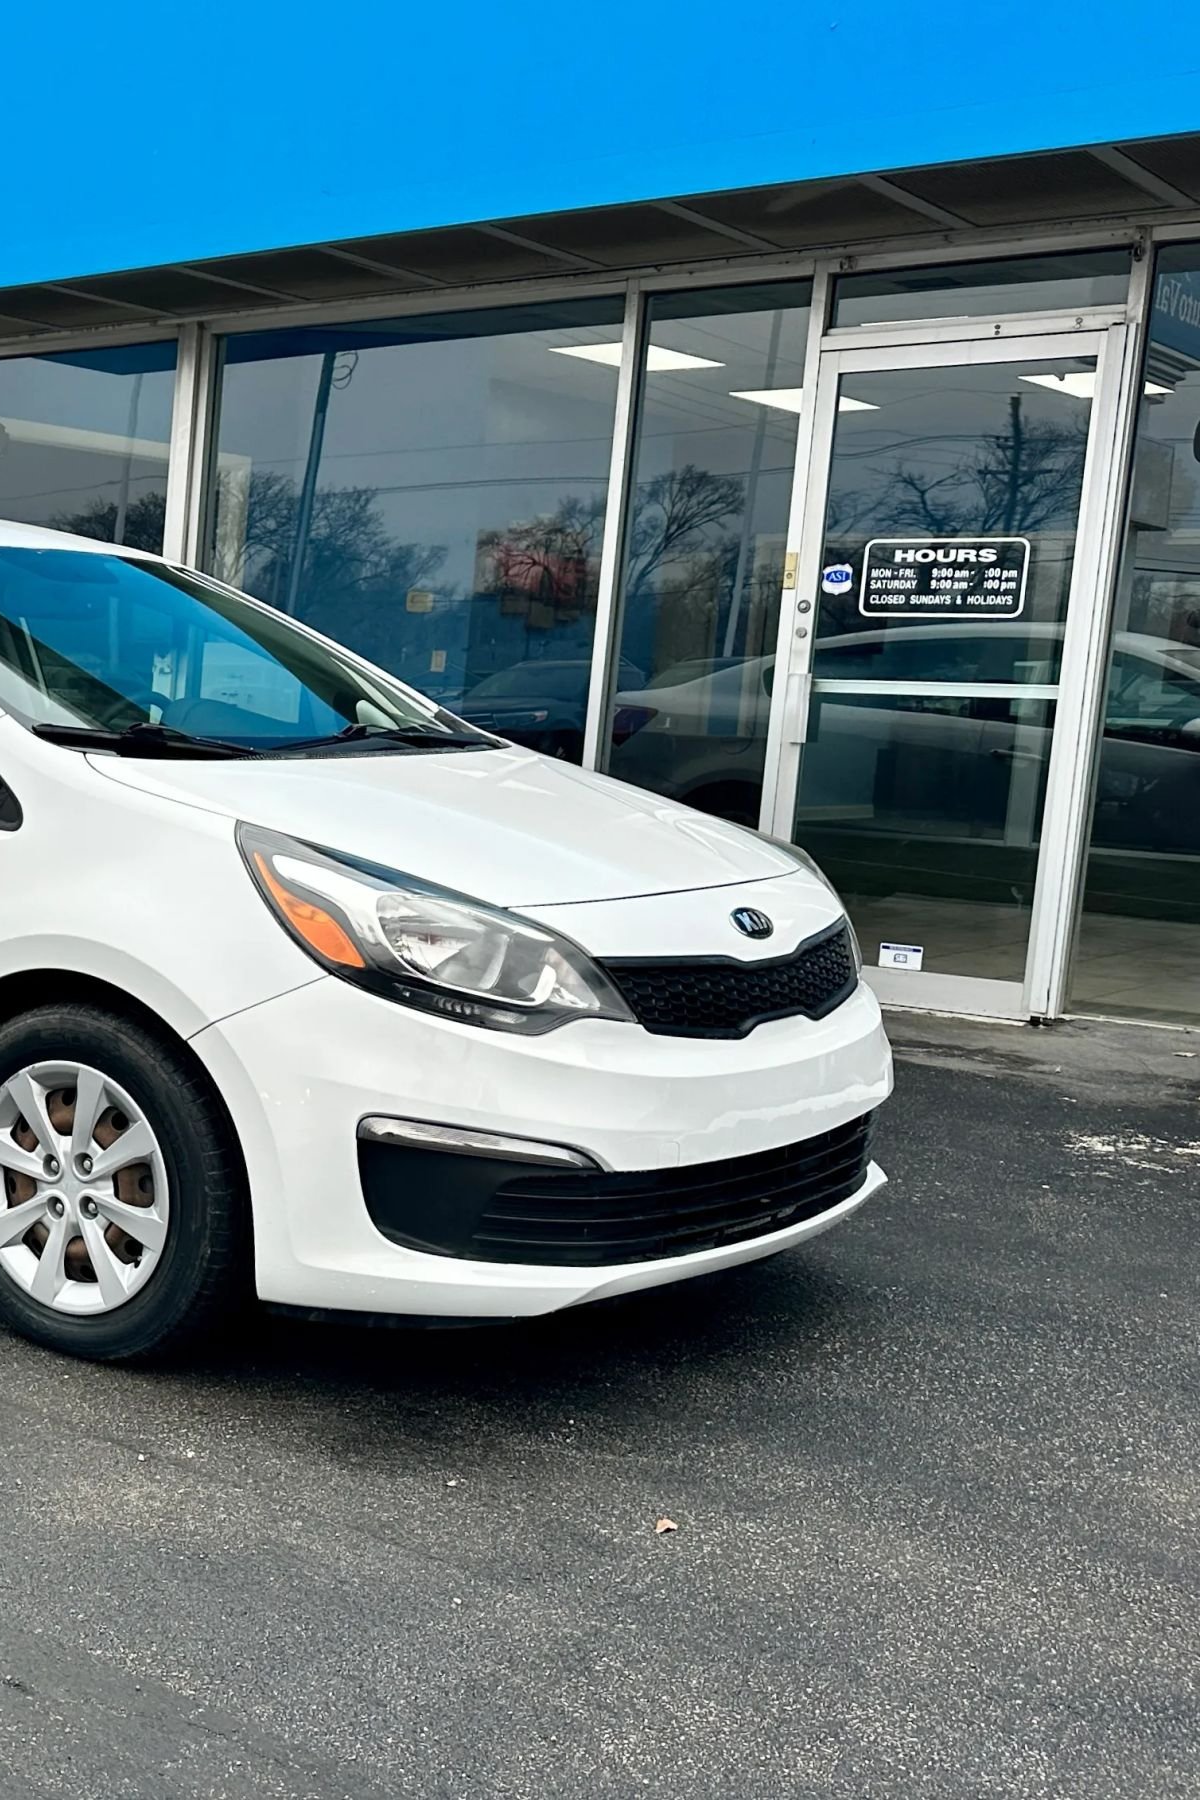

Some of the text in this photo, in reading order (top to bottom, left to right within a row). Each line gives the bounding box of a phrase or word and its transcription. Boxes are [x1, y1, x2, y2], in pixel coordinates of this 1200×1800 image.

[894, 548, 998, 563] HOURS
[1002, 570, 1018, 580] pm
[870, 580, 918, 589] SATURDAY
[1000, 581, 1017, 591] pm
[870, 594, 906, 604] CLOSED
[910, 594, 951, 605] SUNDAYS
[967, 595, 1013, 605] HOLIDAYS
